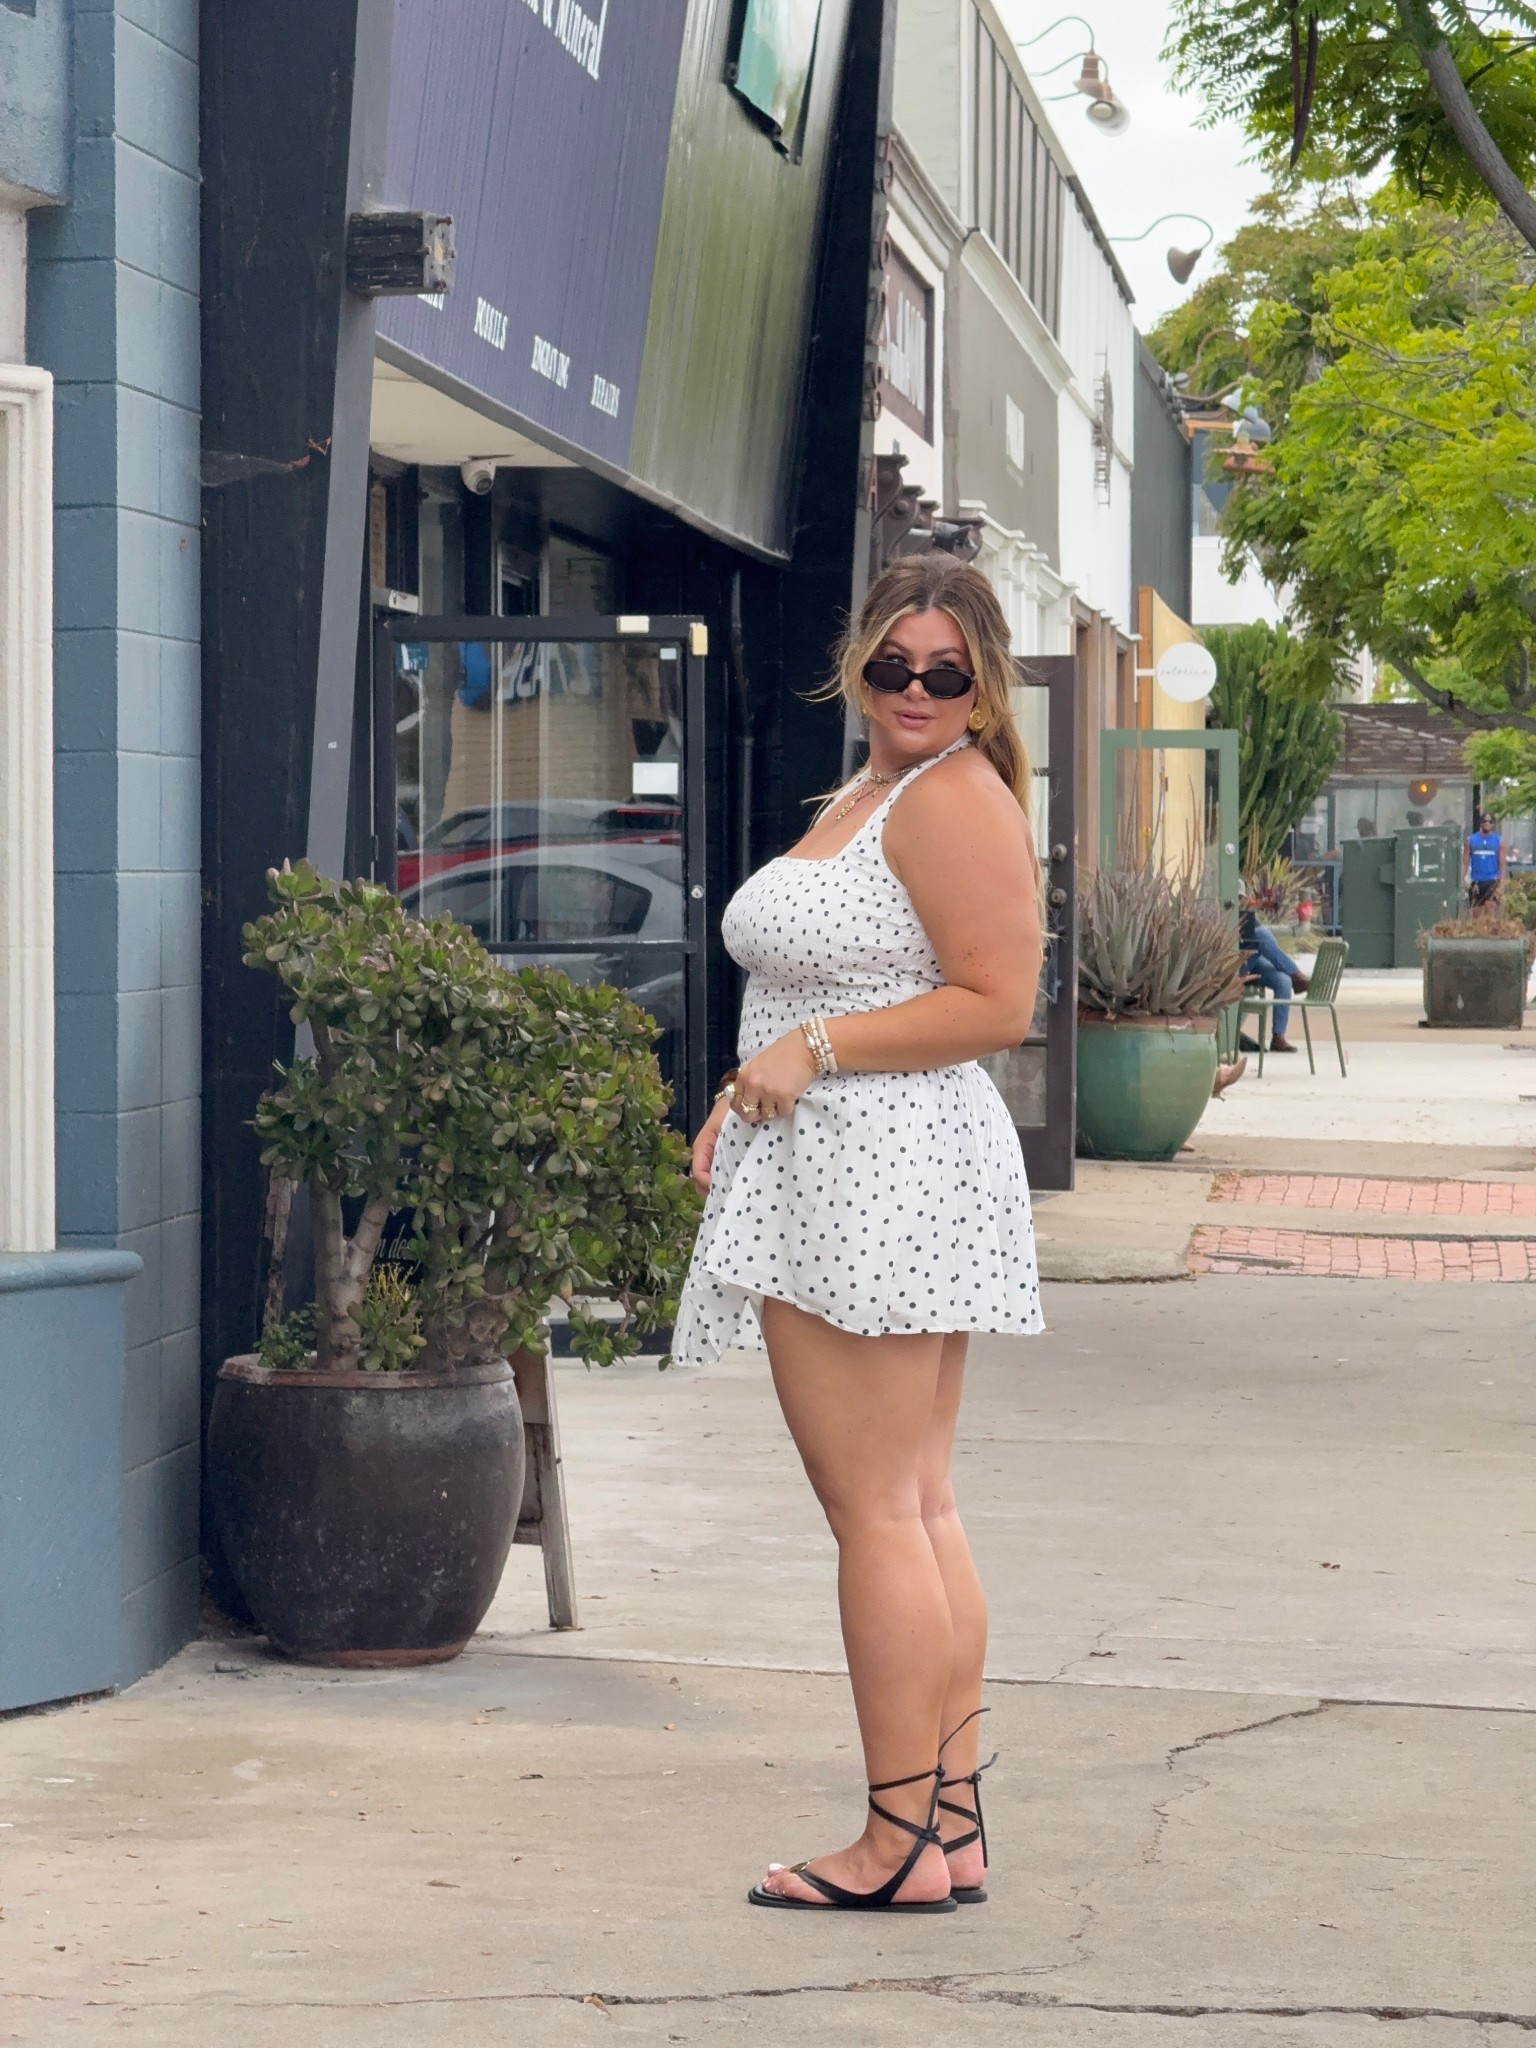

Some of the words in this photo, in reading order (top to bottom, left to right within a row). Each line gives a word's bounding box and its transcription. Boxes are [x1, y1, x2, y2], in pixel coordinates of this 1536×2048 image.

[473, 296, 509, 351] FOSSILS
[530, 334, 571, 390] ENGRAVING
[590, 373, 621, 419] REPAIRS
